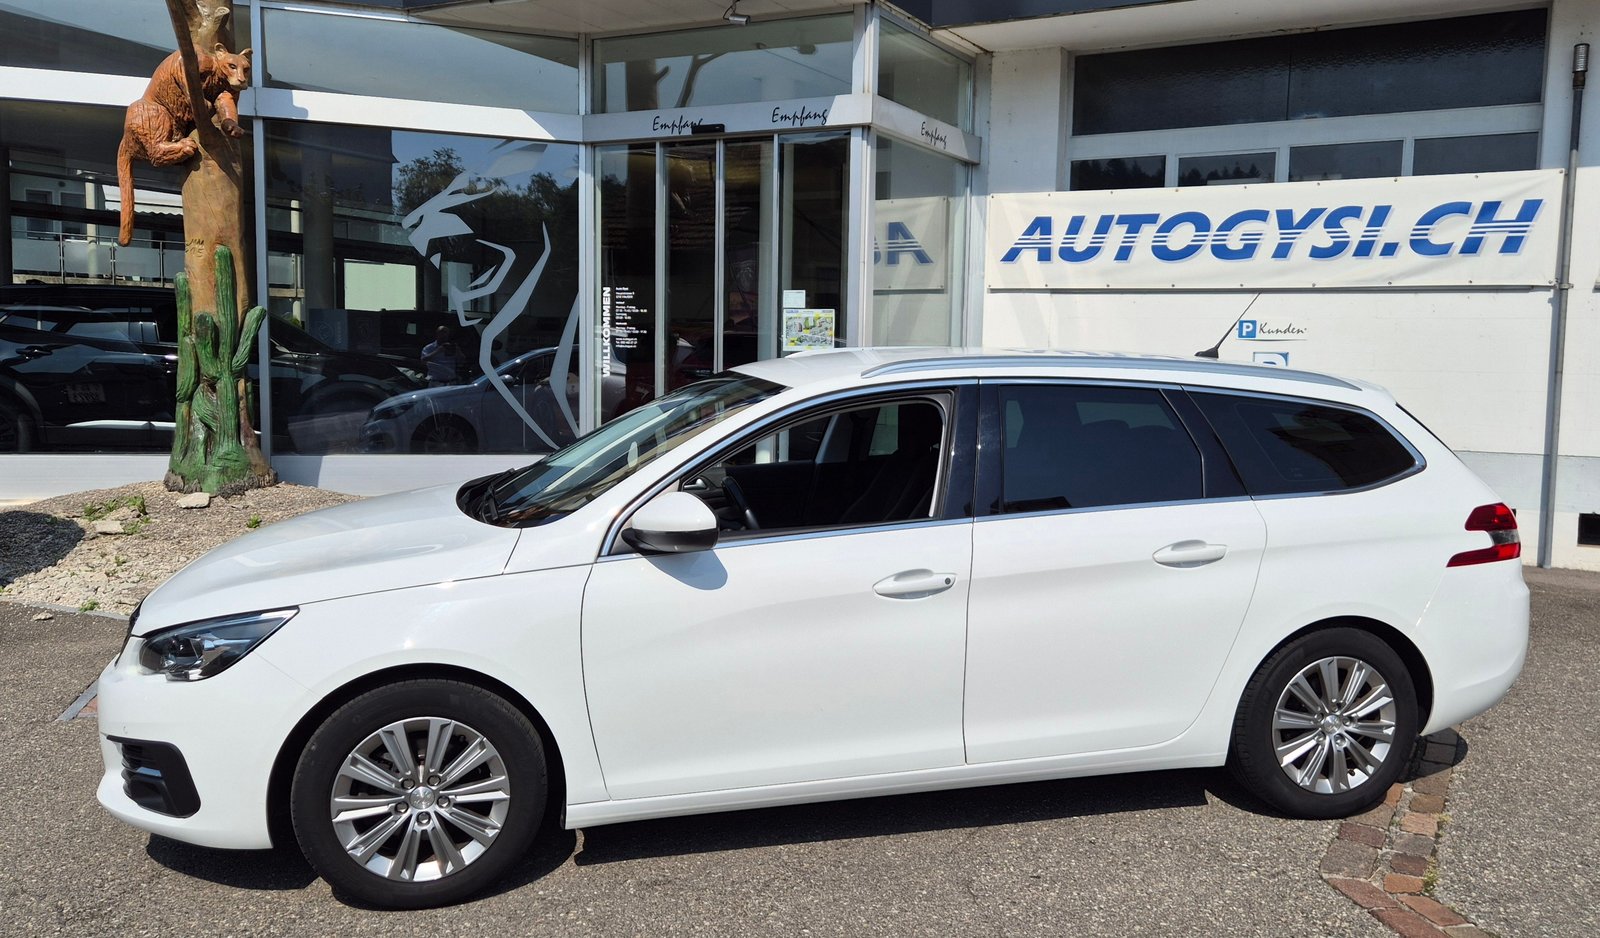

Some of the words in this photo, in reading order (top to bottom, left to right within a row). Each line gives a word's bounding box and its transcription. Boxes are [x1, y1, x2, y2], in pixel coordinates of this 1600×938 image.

[771, 105, 828, 126] Empfang
[920, 121, 947, 149] Empfang
[1000, 199, 1546, 263] AUTOGYSI.CH
[602, 286, 611, 378] WILLKOMMEN
[1241, 322, 1254, 337] P
[1258, 322, 1304, 335] Kunden
